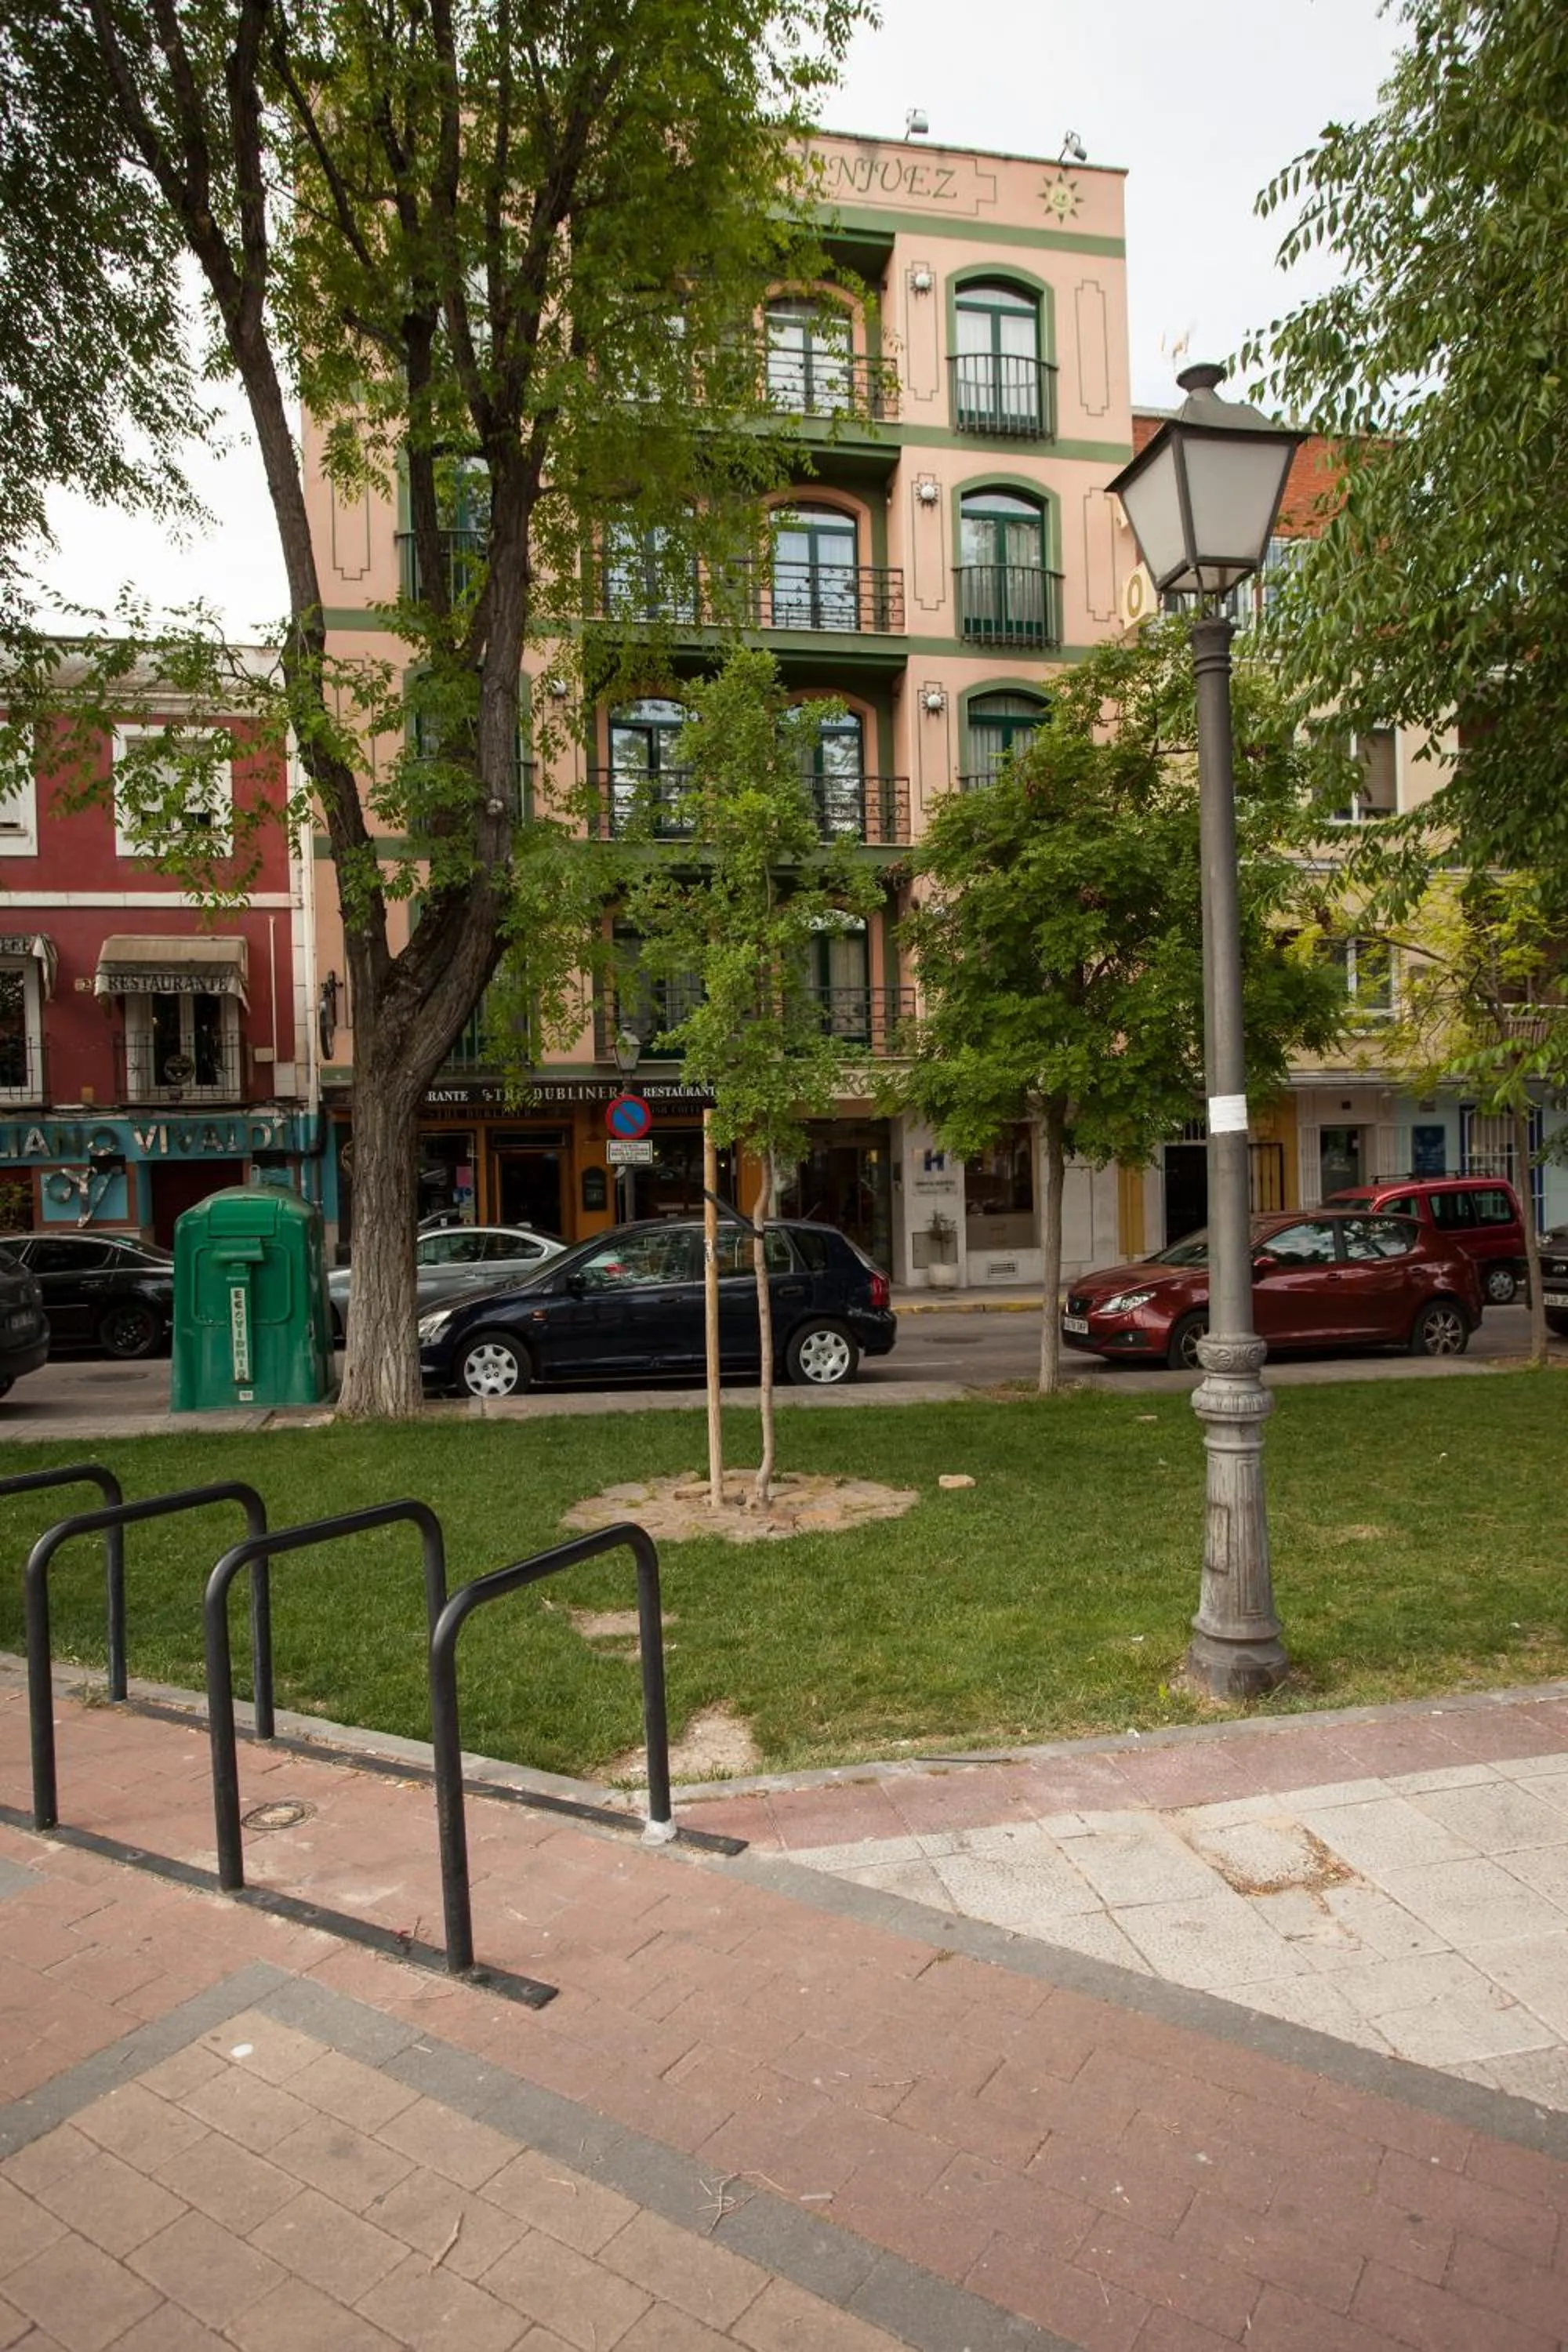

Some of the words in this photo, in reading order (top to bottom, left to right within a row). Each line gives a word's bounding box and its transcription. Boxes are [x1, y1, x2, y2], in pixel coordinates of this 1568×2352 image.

[108, 975, 227, 991] RESTAURANTE
[533, 1086, 618, 1100] DUBLINER
[234, 1290, 246, 1381] ECOVIDRIO
